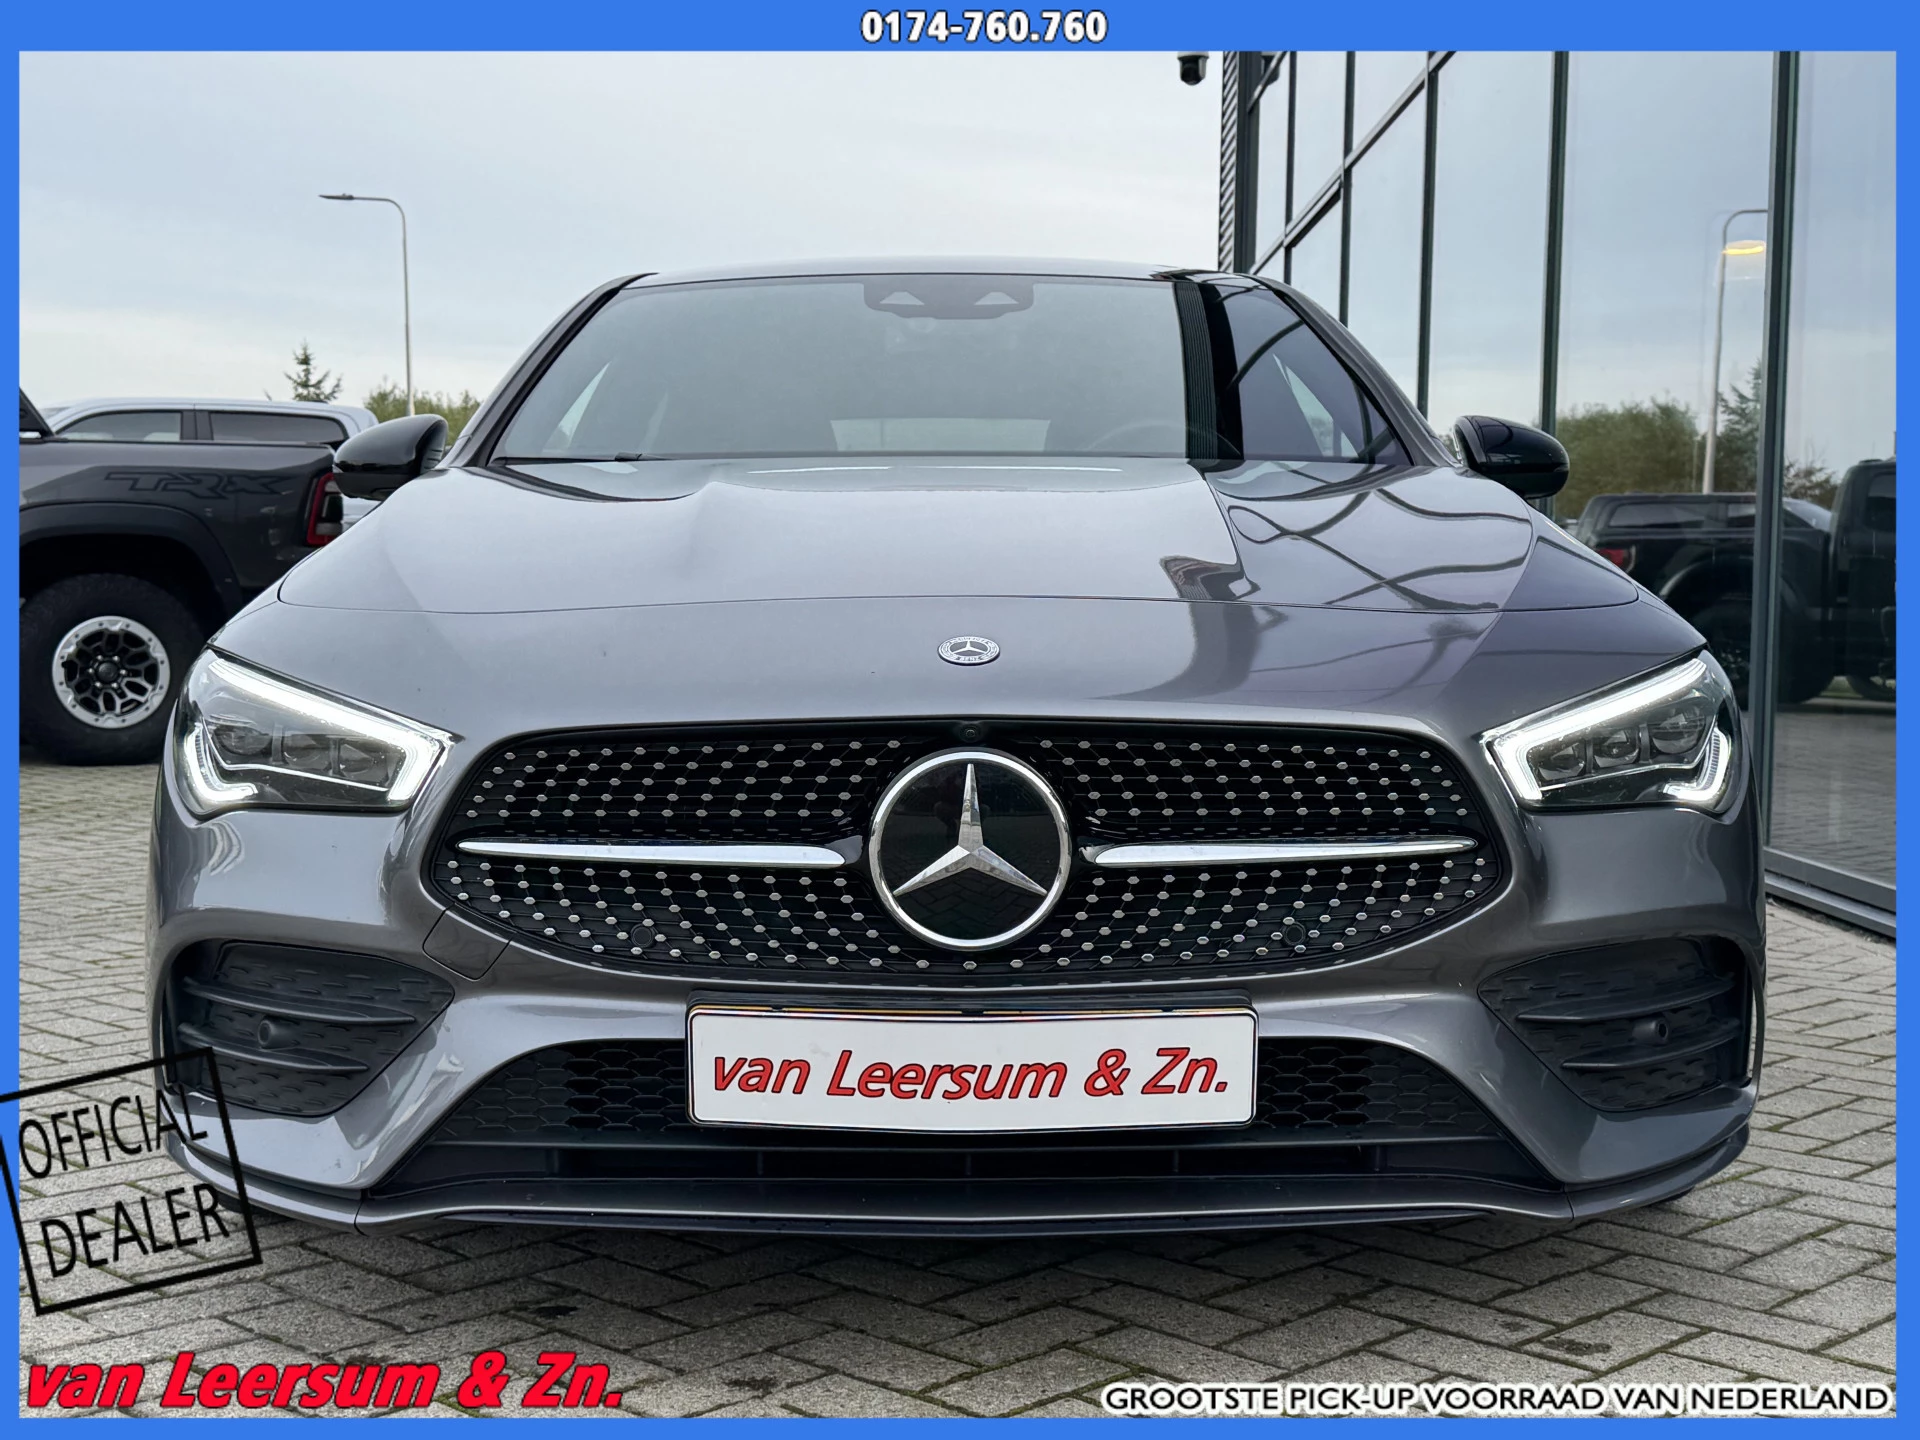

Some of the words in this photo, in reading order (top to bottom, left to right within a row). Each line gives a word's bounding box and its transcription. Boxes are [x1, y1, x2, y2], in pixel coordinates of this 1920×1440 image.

[104, 472, 297, 499] TRX
[714, 1056, 810, 1094] van
[826, 1050, 1067, 1099] Leersum
[1084, 1049, 1130, 1097] &
[1141, 1047, 1229, 1094] Zn.
